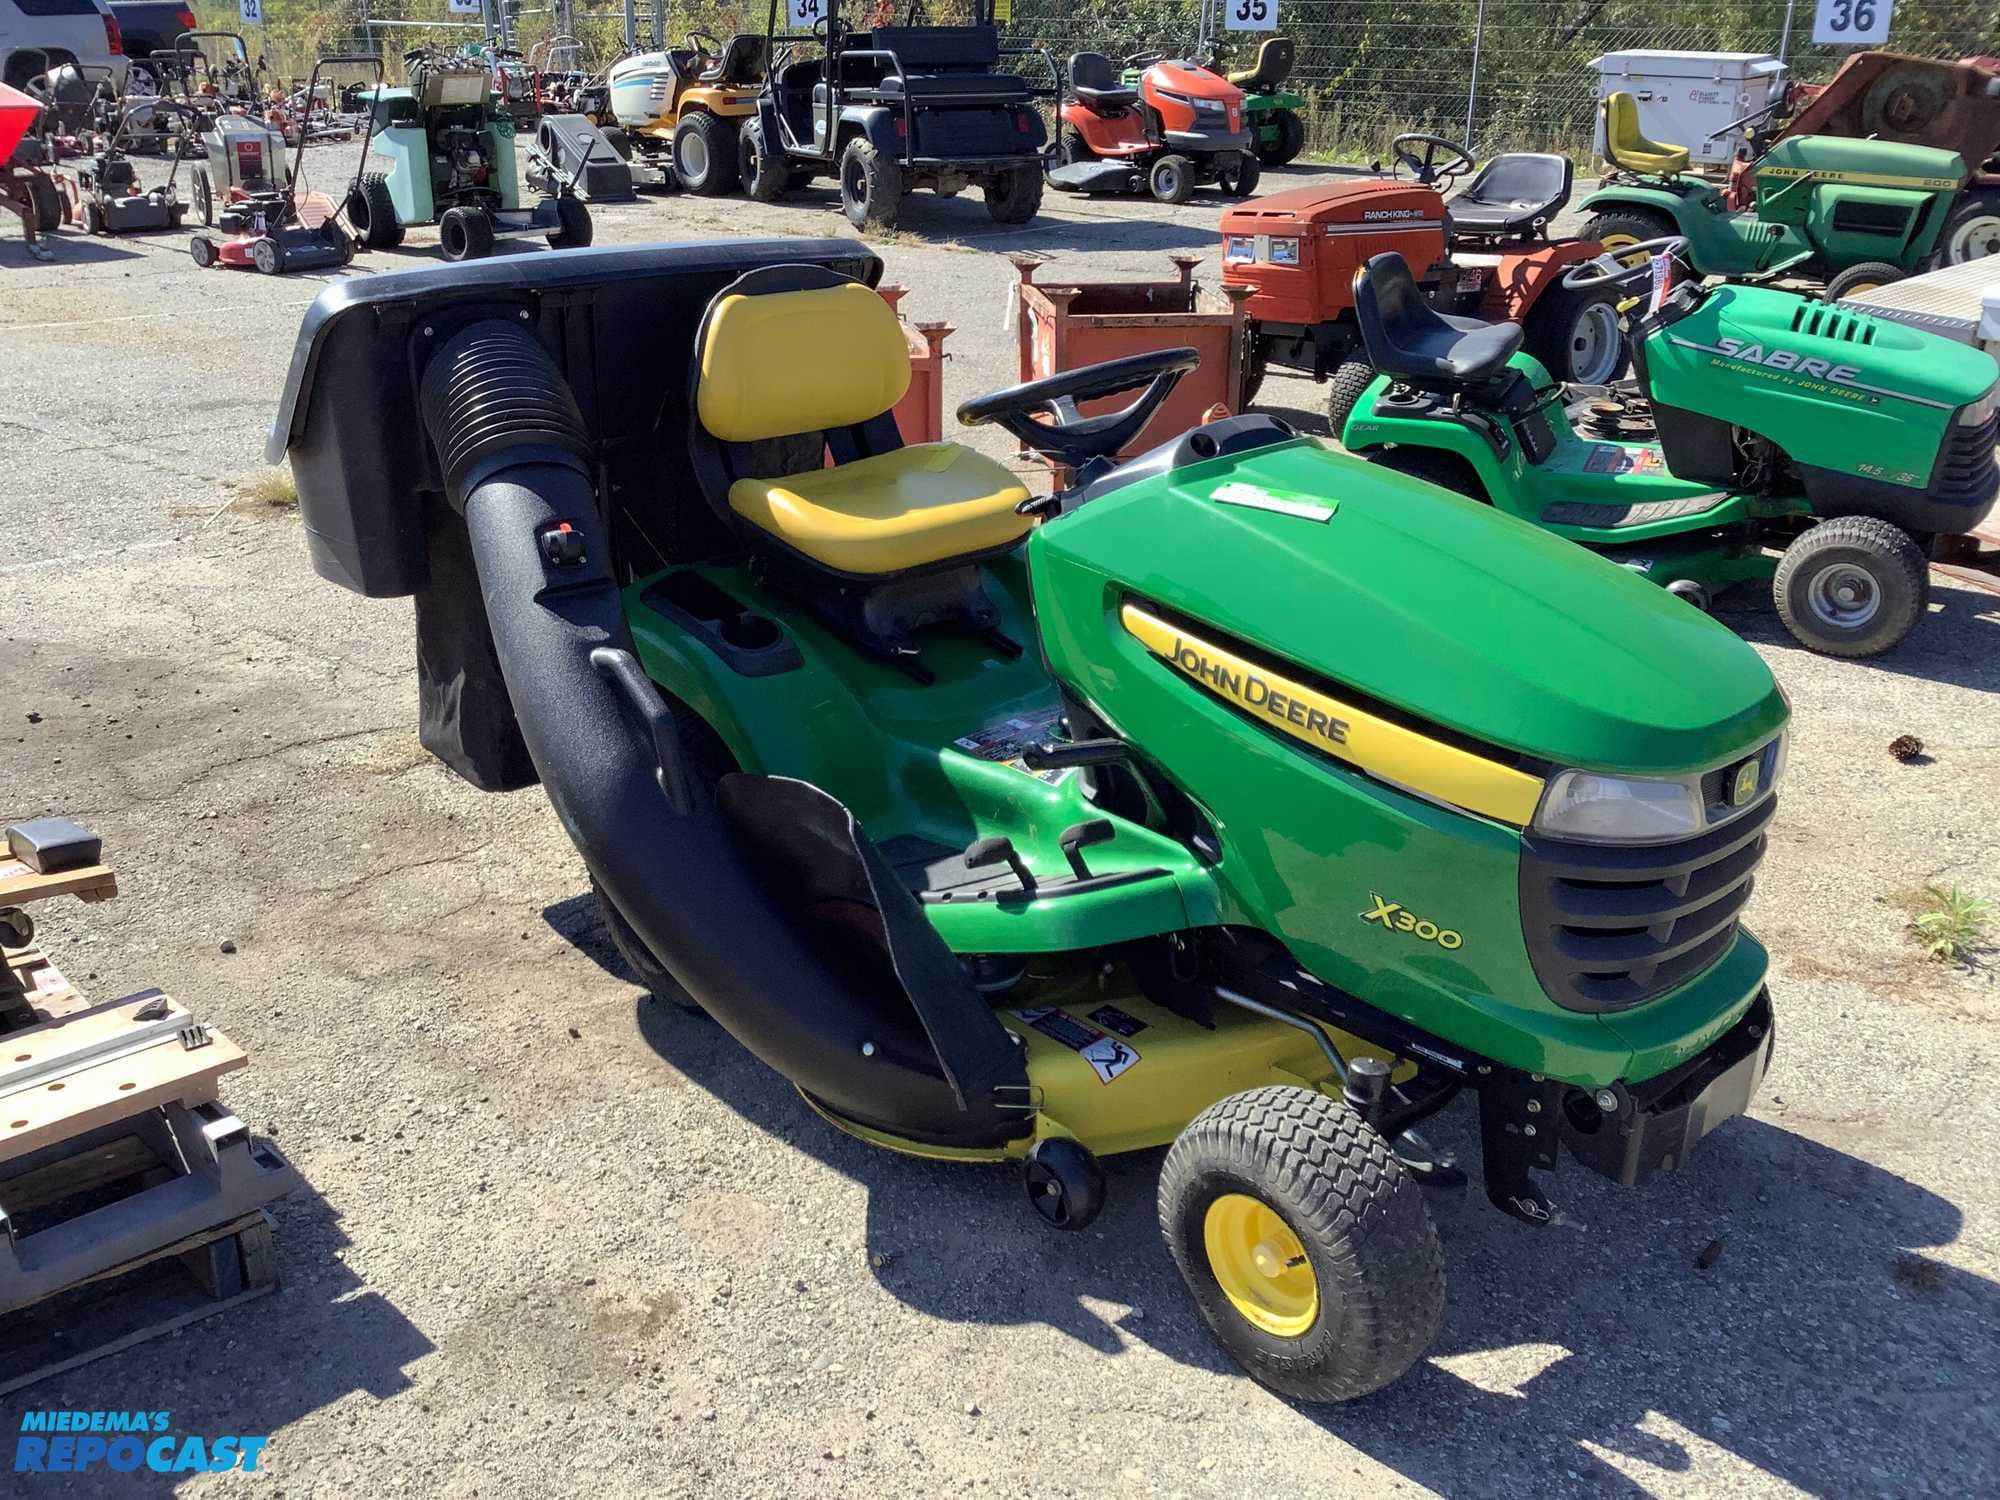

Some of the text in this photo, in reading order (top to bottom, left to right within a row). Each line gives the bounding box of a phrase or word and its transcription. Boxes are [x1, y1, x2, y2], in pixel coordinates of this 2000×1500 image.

[244, 0, 257, 17] 32
[797, 0, 819, 17] 34
[1236, 0, 1267, 20] 35
[1830, 0, 1877, 31] 36
[1768, 168, 1799, 176] JOHN
[1364, 210, 1392, 219] RANCH
[1392, 209, 1410, 218] KING
[1716, 337, 1862, 384] SABRE
[1711, 358, 1867, 401] Manufactured by JOHN DEERE
[1165, 637, 1350, 745] JOHN DEERE
[1359, 890, 1464, 950] X300
